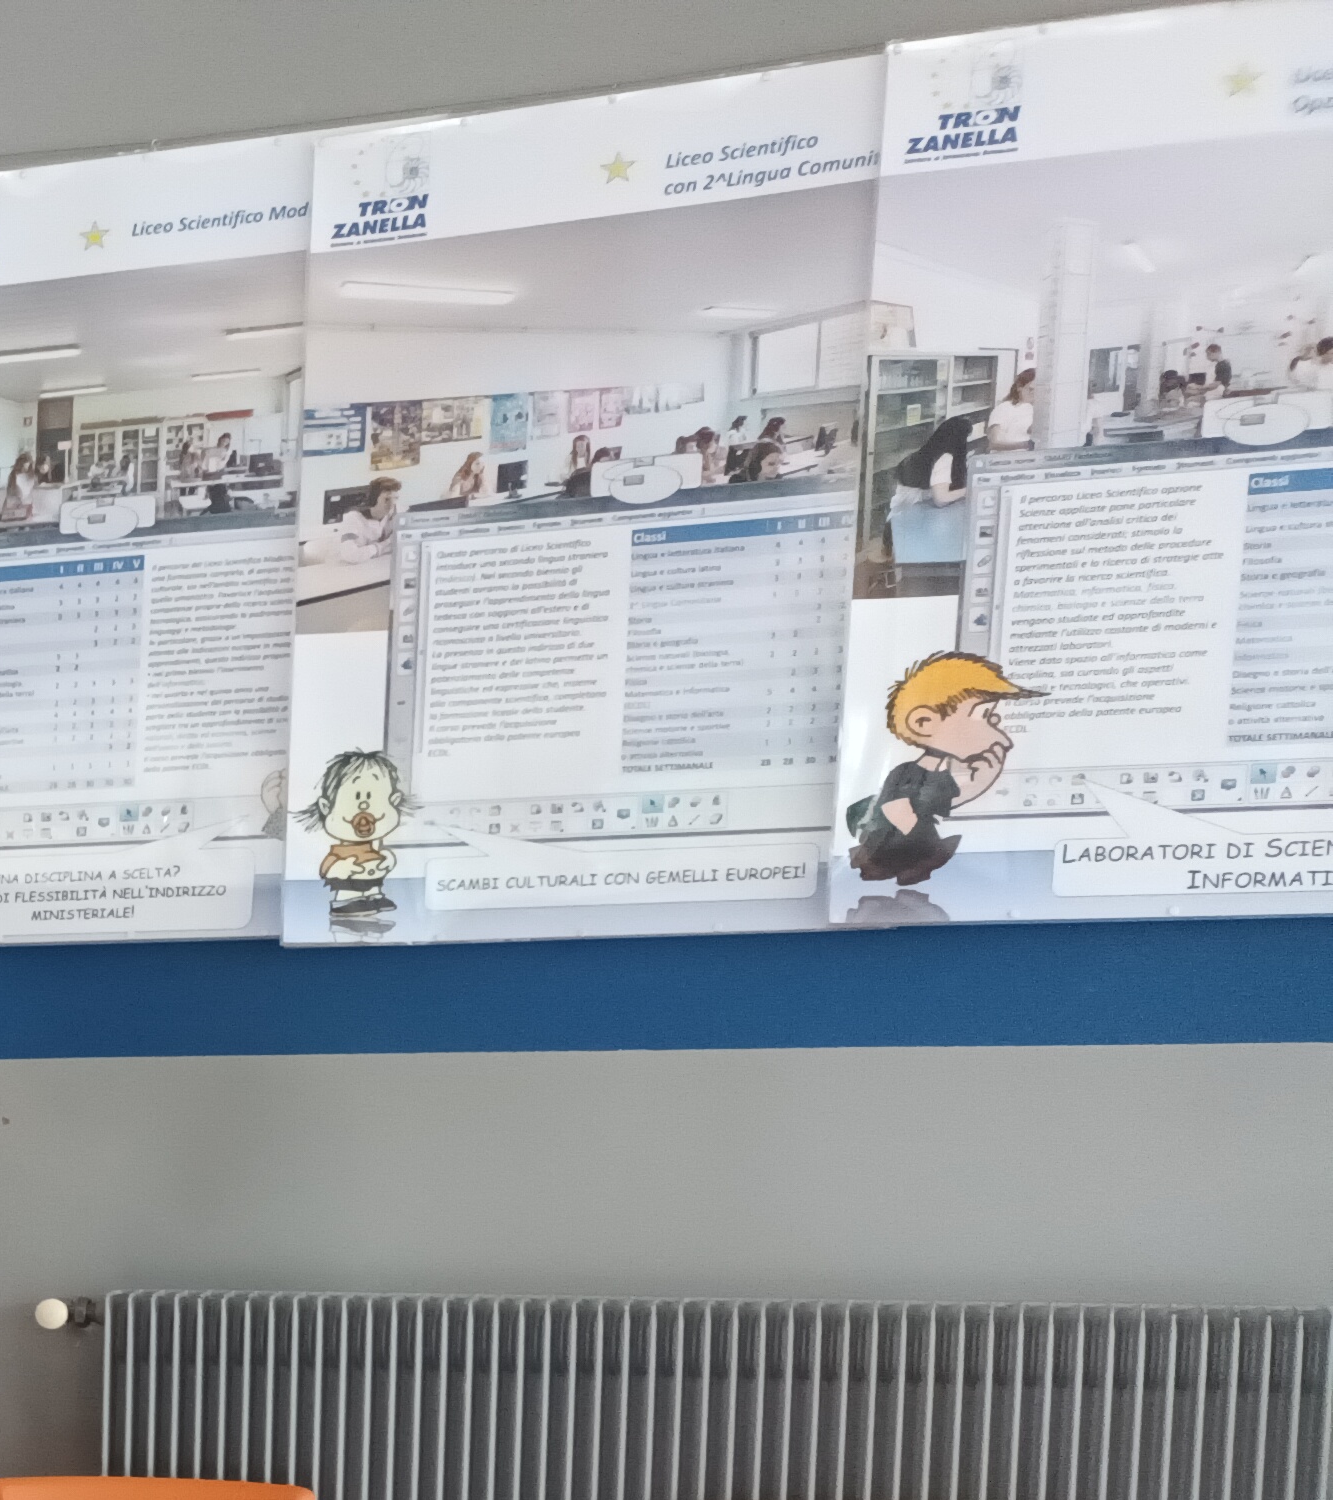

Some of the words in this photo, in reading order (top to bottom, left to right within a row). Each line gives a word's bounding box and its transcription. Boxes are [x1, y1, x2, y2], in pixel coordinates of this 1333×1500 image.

[938, 106, 1021, 129] TRON
[665, 150, 715, 170] Liceo
[720, 133, 819, 162] Scientifico
[905, 127, 1018, 154] ZANELLA
[664, 177, 698, 196] con
[358, 194, 429, 218] TRON
[132, 221, 173, 236] Liceo
[177, 210, 263, 232] Scientifico
[269, 202, 309, 221] Mod
[331, 214, 427, 240] ZANELLA
[633, 532, 666, 543] Classi
[1062, 843, 1216, 863] LABORATORI
[1227, 843, 1254, 859] DI
[25, 870, 103, 883] DISCIPLINA
[109, 870, 117, 879] A
[123, 866, 181, 880] SCELTA?
[437, 877, 499, 892] SCAMBI
[506, 874, 596, 889] CULTURALI
[604, 872, 639, 886] CON
[646, 869, 719, 884] GEMELLI
[726, 862, 806, 881] EUROPEI!
[15, 887, 107, 902] FLESSIBILITÀ
[113, 886, 226, 899] NELL'INDIRIZZO
[31, 905, 134, 921] MINISTERIALE!
